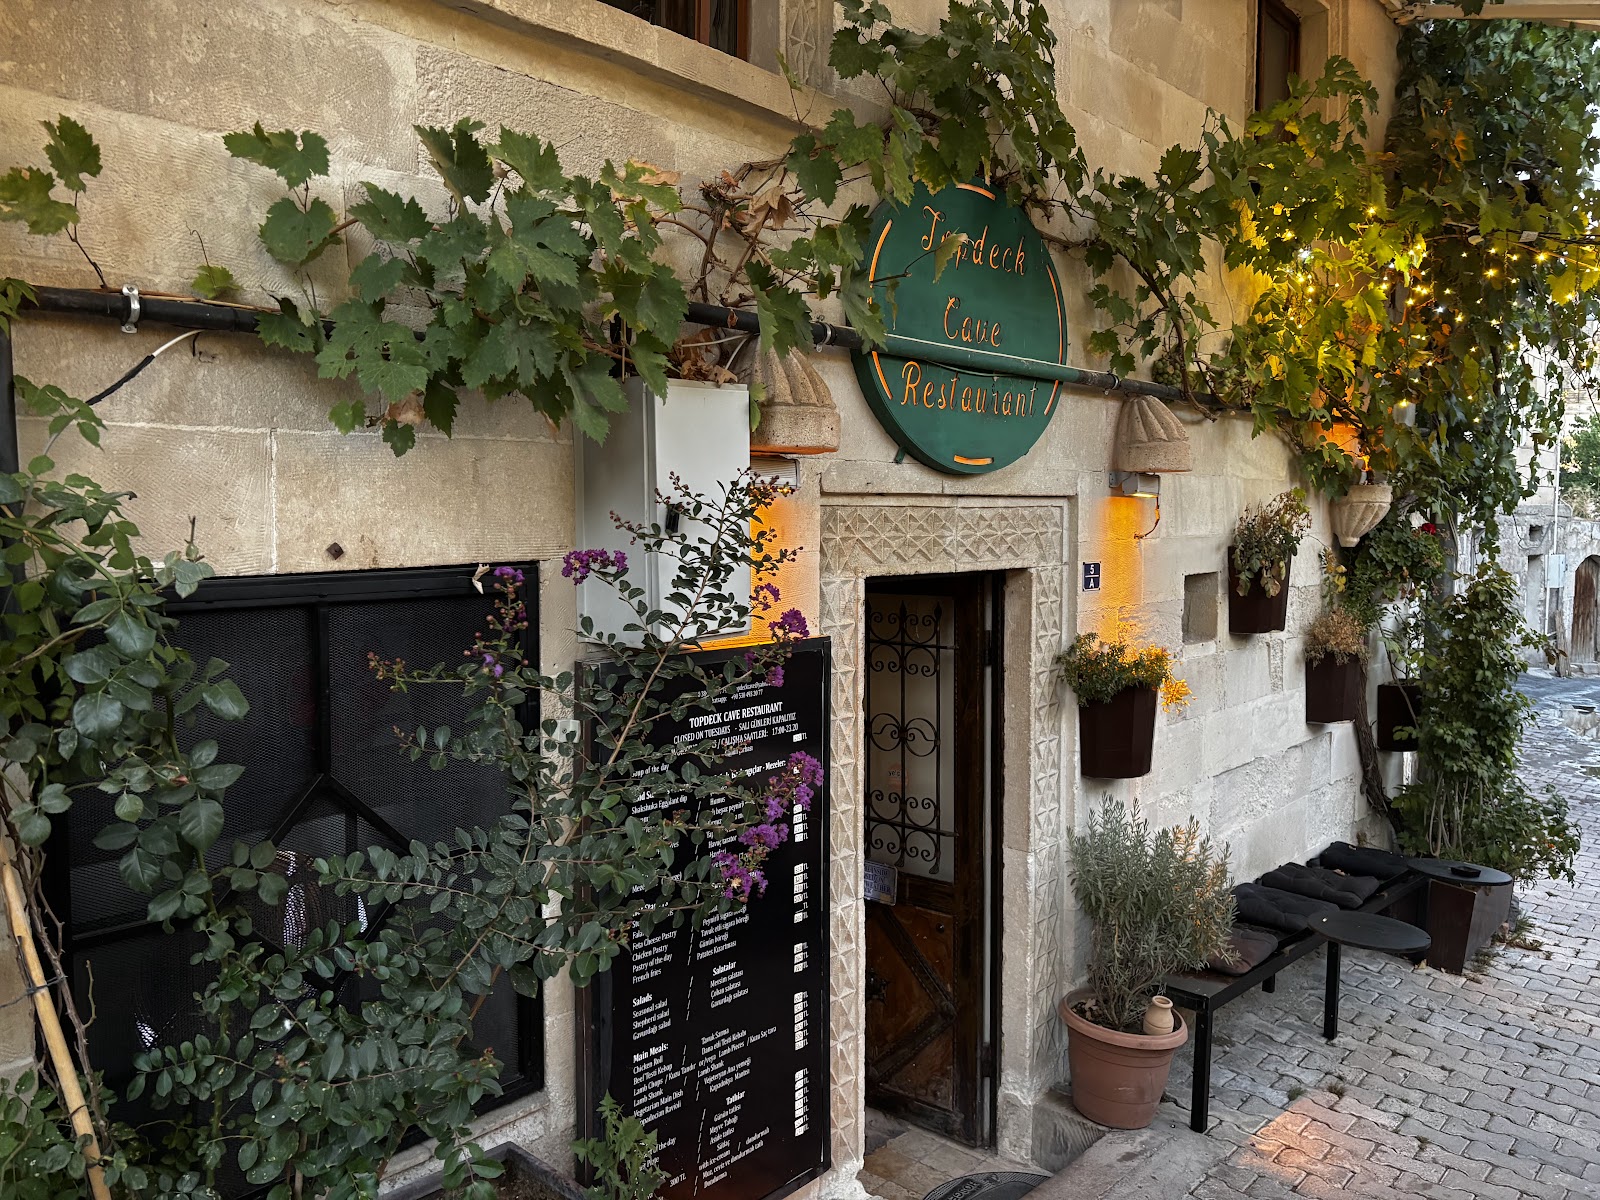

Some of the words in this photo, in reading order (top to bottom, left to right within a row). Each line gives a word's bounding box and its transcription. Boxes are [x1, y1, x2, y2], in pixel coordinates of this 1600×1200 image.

[944, 296, 1002, 346] Cave
[901, 360, 1038, 416] Restaurant
[1090, 564, 1094, 574] 5
[1089, 578, 1094, 588] A
[689, 713, 722, 728] TOPDECK
[724, 710, 740, 721] CAVE
[742, 702, 782, 718] RESTAURANT
[674, 733, 695, 744] CLOSED
[696, 731, 703, 740] ON
[704, 725, 730, 738] TUESDAYS
[739, 722, 749, 731] SALI
[645, 766, 650, 774] of
[661, 761, 670, 772] day
[632, 802, 658, 814] Shakshuka
[662, 931, 677, 940] Pastry
[632, 950, 652, 961] Chicken
[653, 944, 668, 954] Pastry
[633, 962, 648, 973] Pastry
[713, 962, 736, 976] Salatalar
[633, 972, 649, 984] French
[651, 969, 661, 977] fries
[633, 993, 652, 1007] Salads
[633, 1004, 654, 1018] Seasonal
[655, 998, 667, 1010] salad
[633, 1014, 656, 1029] Shepherd
[657, 1008, 669, 1020] salad
[658, 1018, 671, 1030] salad
[634, 1051, 648, 1063] Main
[650, 1043, 668, 1056] Meals:
[633, 1062, 652, 1074] Chicken
[698, 1066, 710, 1078] Lamb
[710, 1060, 724, 1072] Shank
[634, 1074, 644, 1085] Beef
[634, 1084, 647, 1096] Lamb
[648, 1079, 663, 1089] Chops
[633, 1102, 659, 1118] Vegetarian
[660, 1096, 672, 1105] Main
[673, 1089, 683, 1100] Dish
[634, 1095, 647, 1107] Lamb
[648, 1088, 663, 1100] Shank
[670, 1175, 680, 1187] 300
